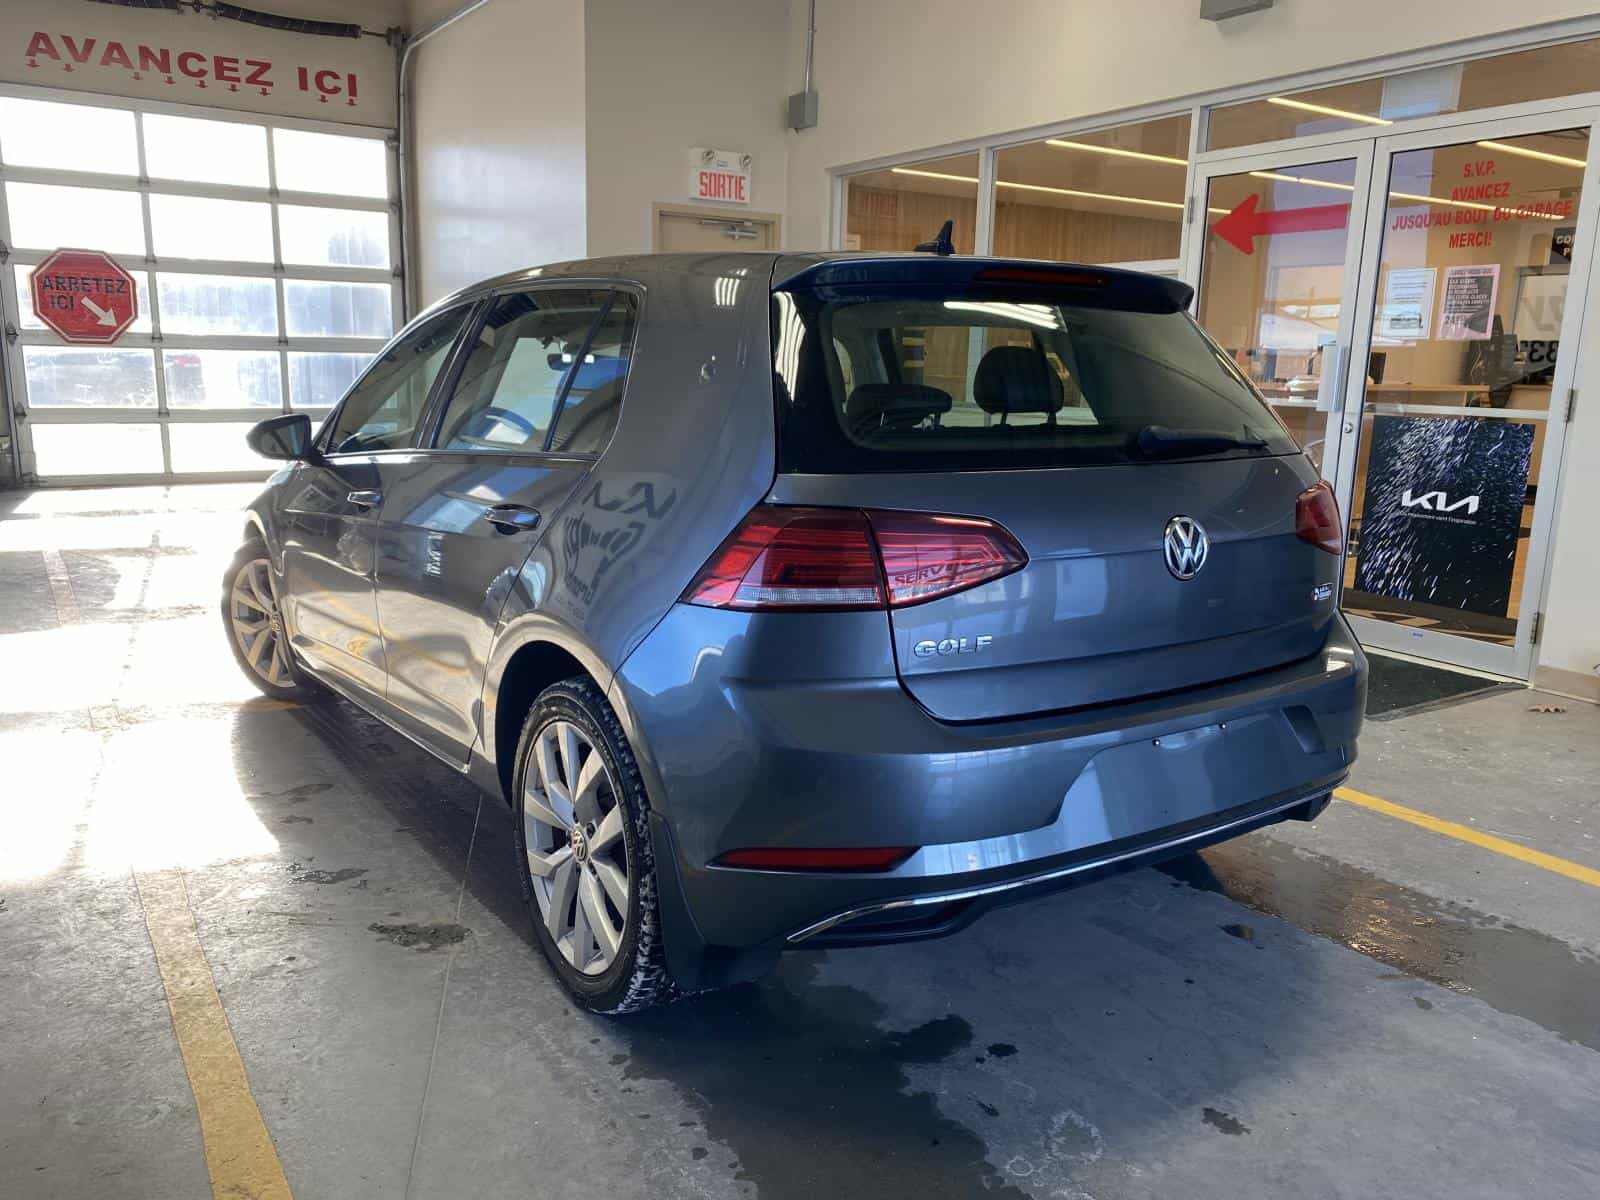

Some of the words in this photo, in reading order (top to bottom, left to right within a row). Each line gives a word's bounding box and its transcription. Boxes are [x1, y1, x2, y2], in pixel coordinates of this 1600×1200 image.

[25, 31, 274, 88] AVANCEZ
[297, 66, 358, 98] ICI
[1463, 161, 1495, 178] S.V.P.
[699, 171, 746, 201] SORTIE
[1451, 182, 1511, 202] AVANCEZ
[1392, 212, 1450, 231] JUSQU'AU
[1455, 207, 1490, 226] BOUT
[1493, 205, 1512, 223] DU
[1516, 199, 1573, 220] GARAGE
[1449, 231, 1492, 249] MERCI!
[1556, 235, 1574, 245] CO
[42, 275, 128, 295] ARRETEZ
[48, 294, 75, 310] ICI
[1401, 487, 1480, 515] KIA
[913, 635, 993, 657] GOLF
